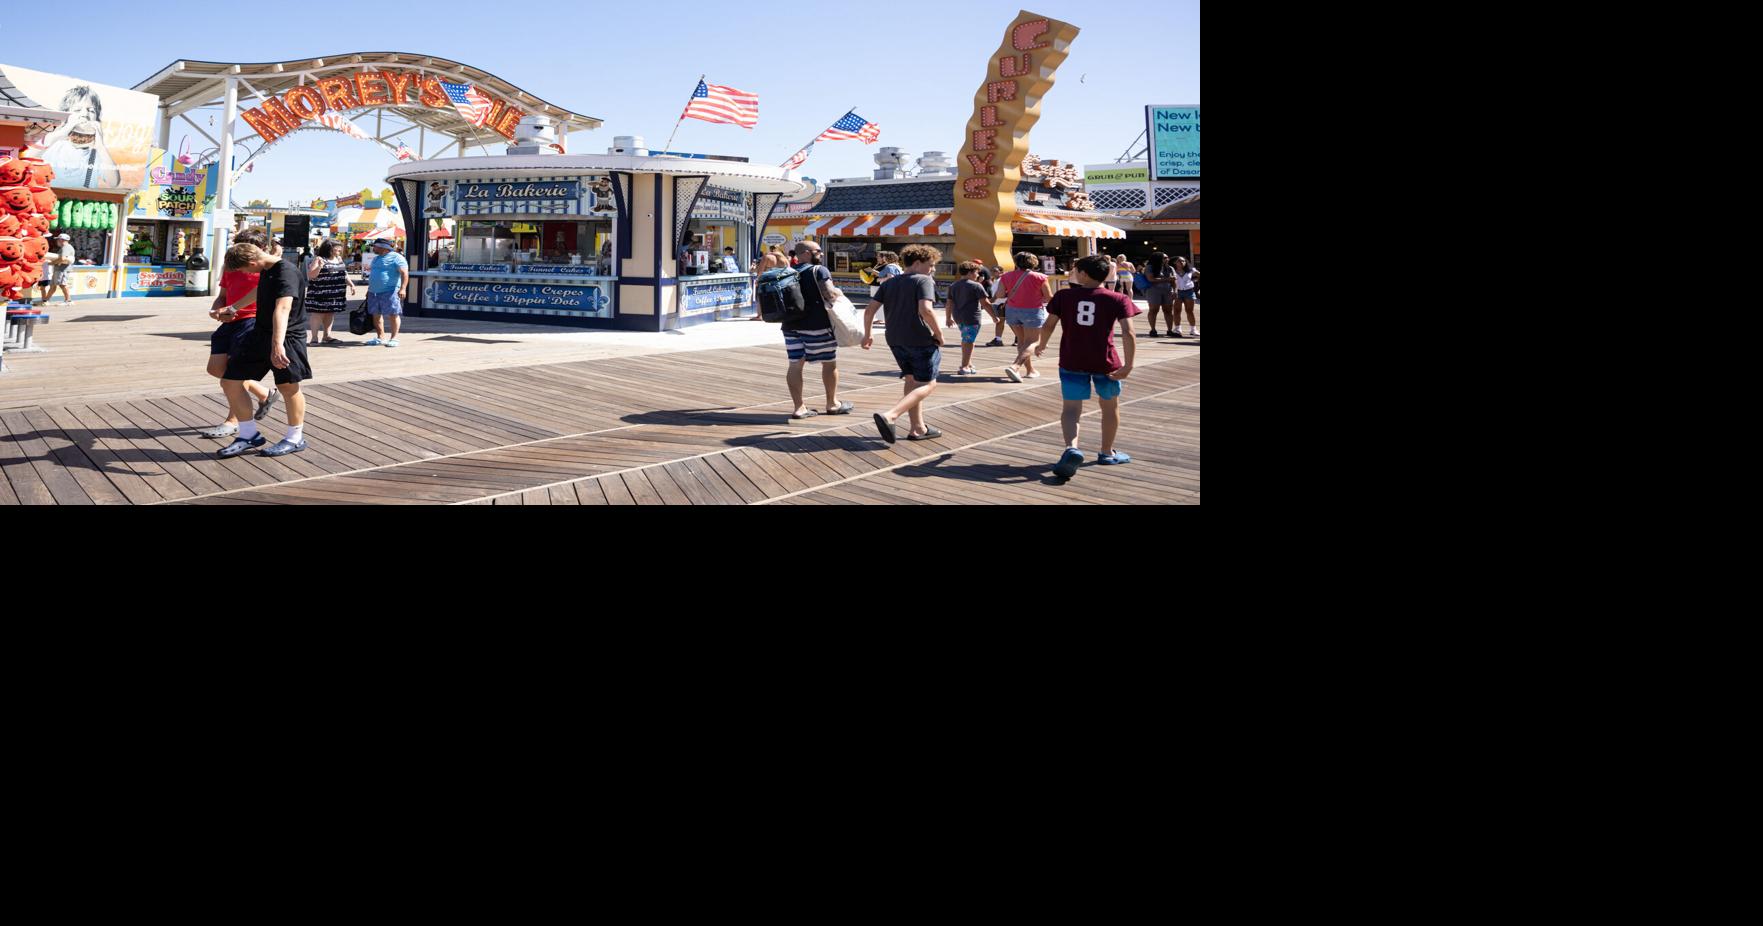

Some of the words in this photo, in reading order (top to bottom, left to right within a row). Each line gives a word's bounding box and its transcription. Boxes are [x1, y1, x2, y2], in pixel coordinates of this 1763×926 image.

[240, 70, 451, 143] MOREY'S
[963, 18, 1050, 200] CURLEY'S
[1156, 110, 1192, 120] New
[1157, 122, 1192, 132] New
[1159, 160, 1185, 168] crisp,
[464, 183, 489, 199] La
[495, 183, 567, 199] Bakerie
[160, 193, 194, 202] SOUR
[158, 201, 196, 210] PATCH
[528, 264, 555, 273] Funnel
[448, 282, 489, 292] Funnel
[492, 284, 528, 294] Cakes
[541, 286, 584, 297] Crepes
[453, 293, 489, 303] Coffee
[551, 297, 580, 306] Dots
[1076, 301, 1096, 326] 8
